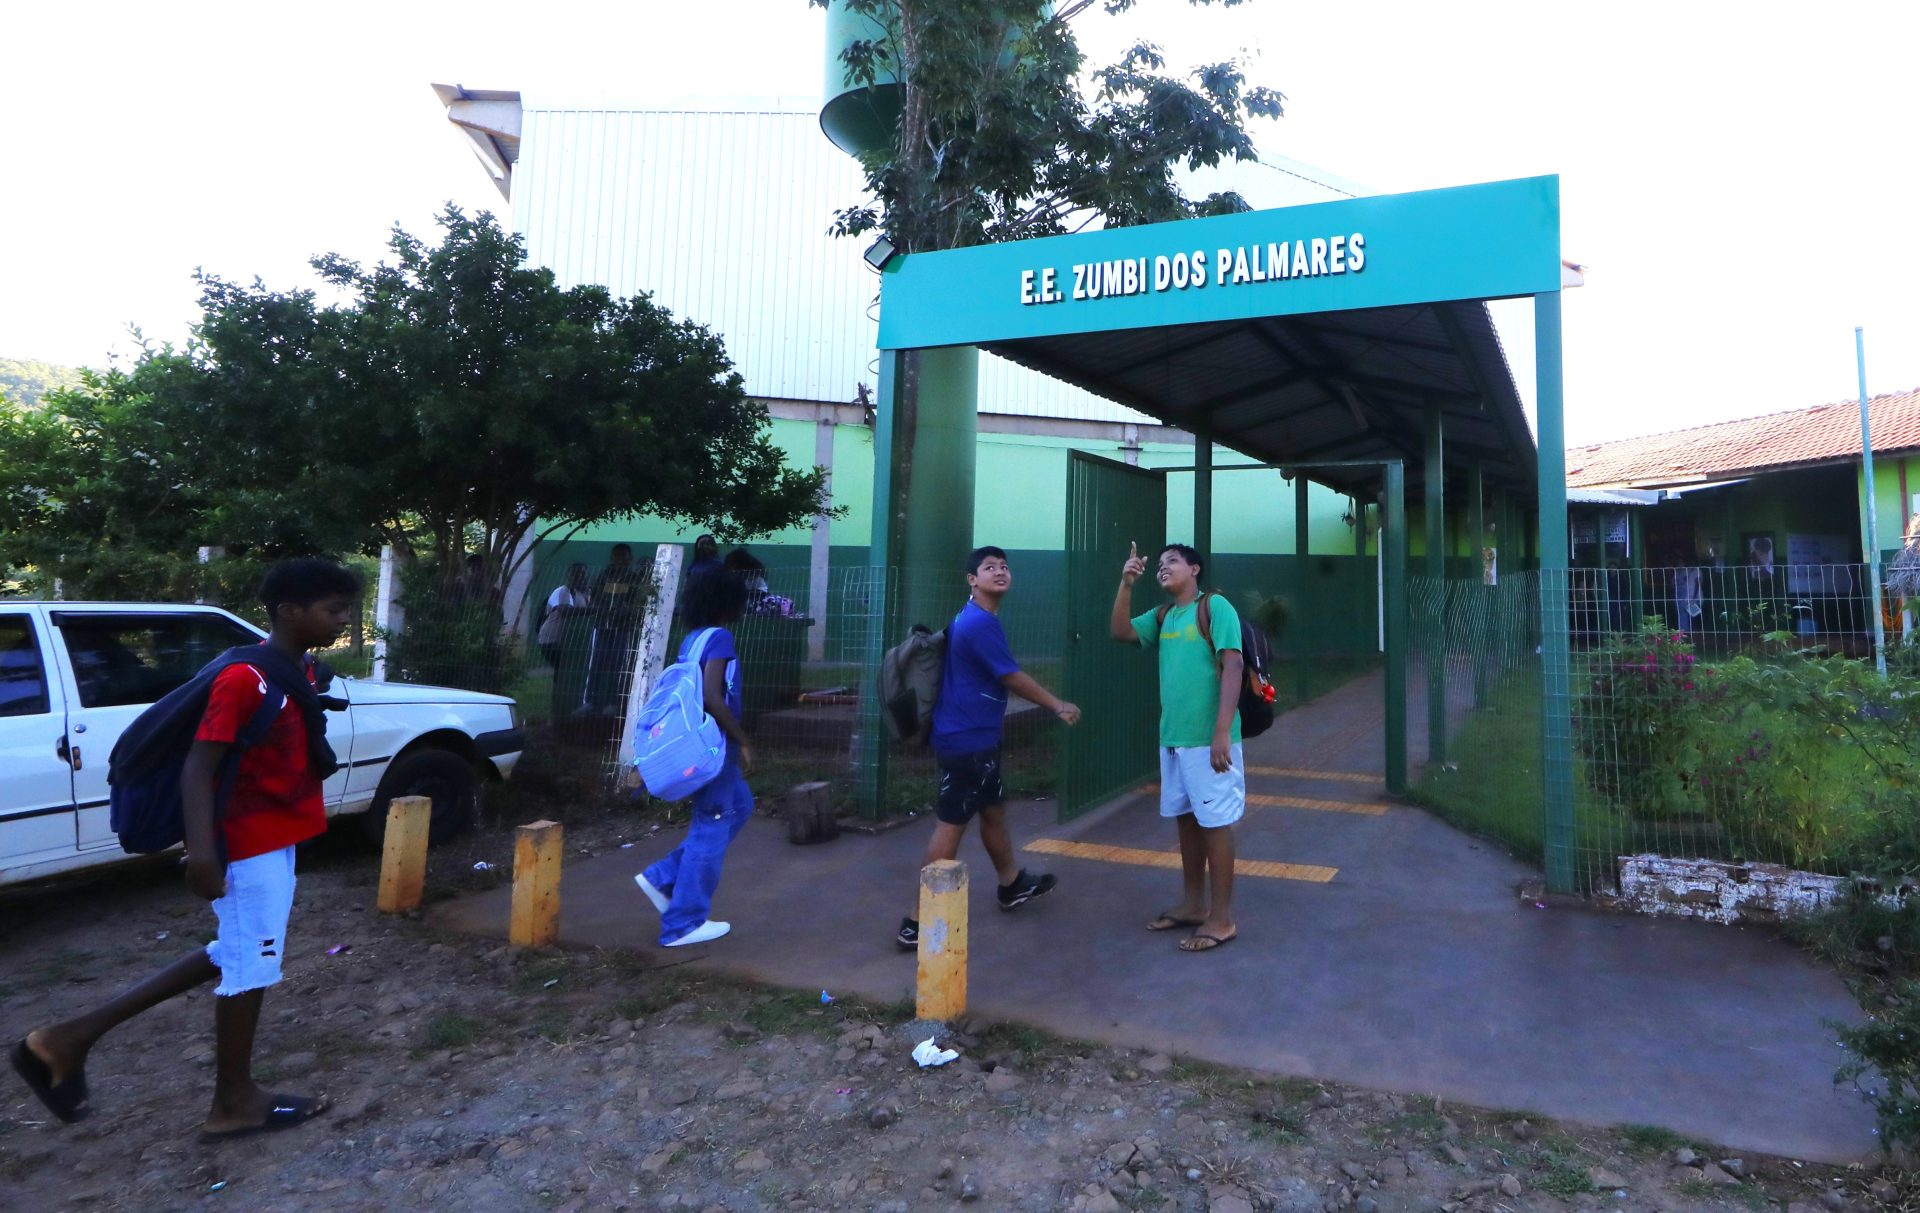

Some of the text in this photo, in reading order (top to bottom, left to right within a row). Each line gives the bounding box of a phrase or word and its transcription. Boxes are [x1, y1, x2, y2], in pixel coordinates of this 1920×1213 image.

[1020, 232, 1366, 305] E.E. ZUMBI DOS PALMARES
